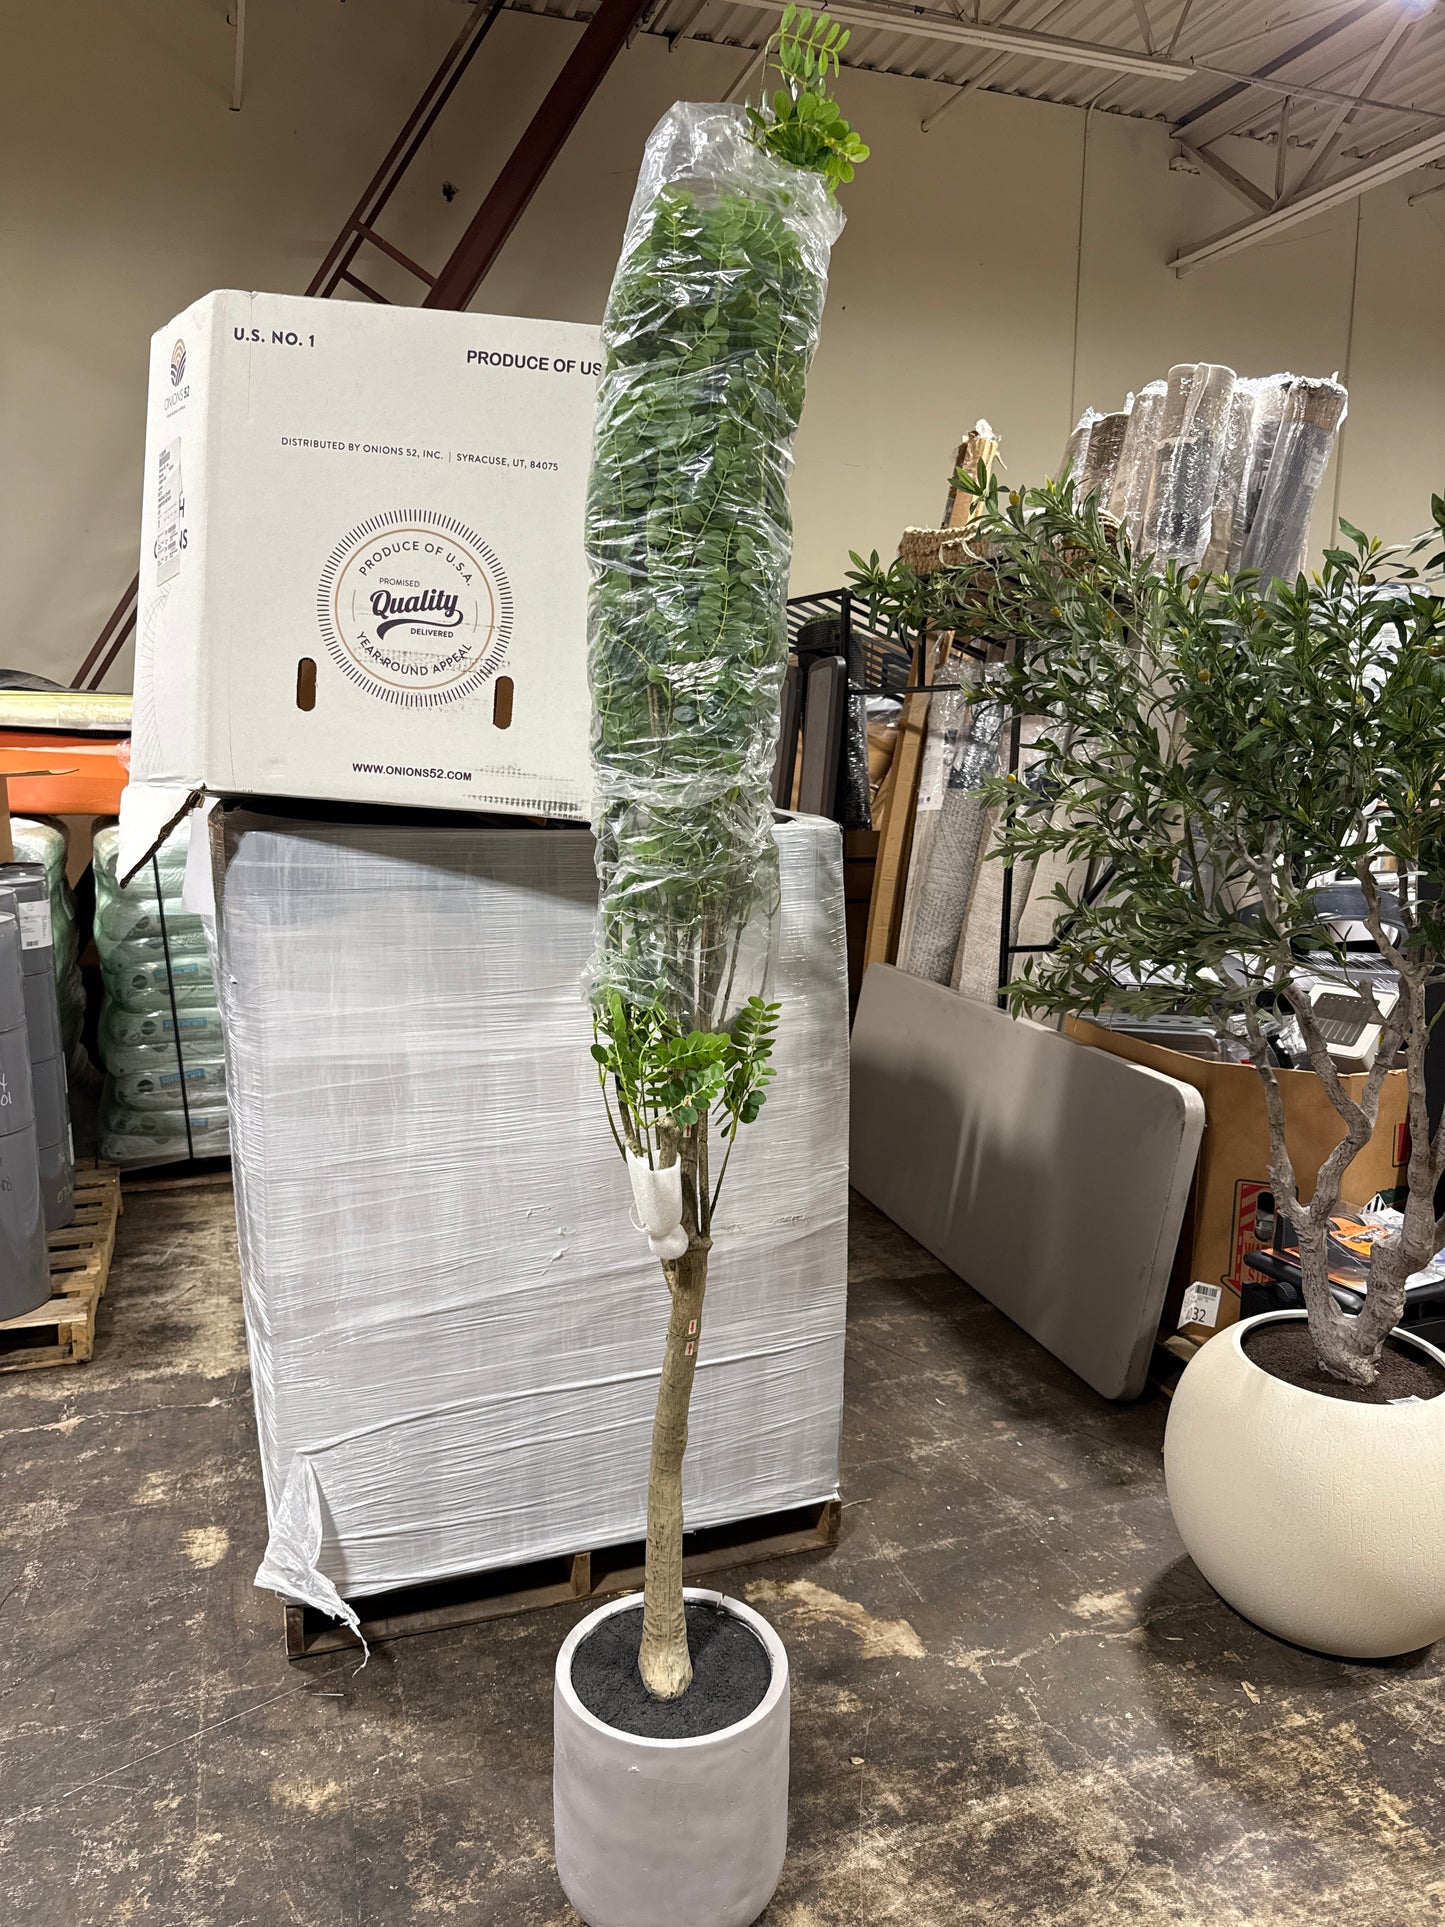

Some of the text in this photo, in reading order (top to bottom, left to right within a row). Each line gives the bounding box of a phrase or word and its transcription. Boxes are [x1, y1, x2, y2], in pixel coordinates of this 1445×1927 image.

[234, 327, 315, 348] U.S. NO. 1
[467, 350, 550, 371] PRODUCE
[553, 358, 577, 373] OF
[281, 437, 559, 471] DISTRIBUTED BY ONIONS 52, INC. SYRACUSE, UT, 84075
[359, 541, 473, 586] PRODUCE OF U.S.A.
[379, 577, 421, 588] PROMISED
[369, 588, 464, 630] Quality
[410, 628, 454, 638] DELIVERED
[357, 631, 472, 676] YEAR-ROUND APPEAL
[352, 763, 472, 781] WWW.ONIONS52.COM
